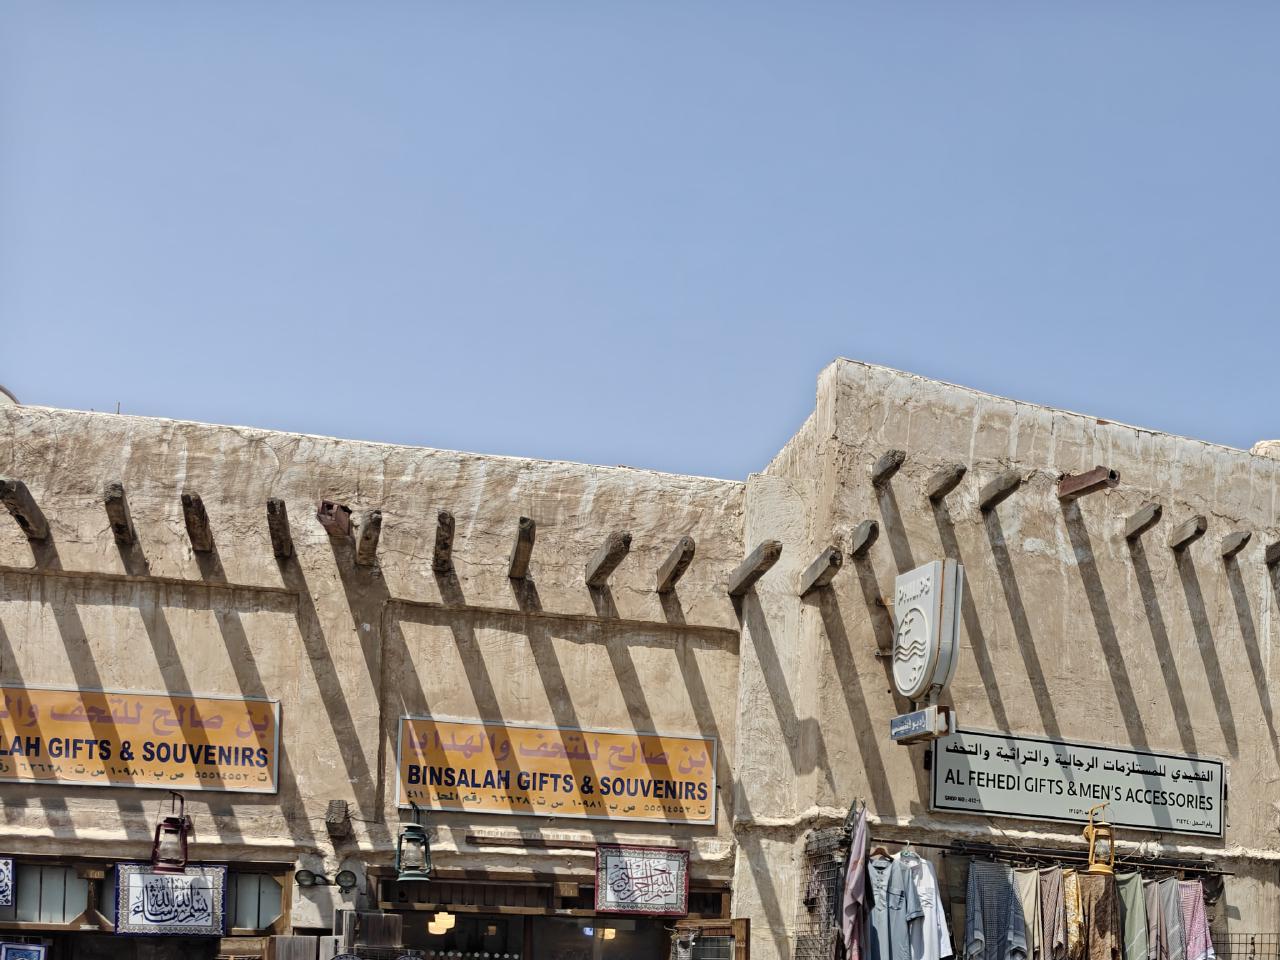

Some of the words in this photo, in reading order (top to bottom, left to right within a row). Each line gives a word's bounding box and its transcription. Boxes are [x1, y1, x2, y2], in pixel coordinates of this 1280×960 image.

[50, 697, 143, 725] للتحف
[151, 703, 225, 736] صالح
[235, 709, 270, 739] بن
[48, 737, 112, 761] GIFTS
[119, 741, 135, 762] &
[142, 741, 269, 768] SOUVENIRS
[408, 729, 511, 762] والهدايا
[519, 732, 600, 761] للتحف
[607, 741, 670, 771] صالح
[677, 745, 707, 775] بن
[945, 742, 990, 761] والتحف
[995, 745, 1050, 767] والتراثية
[1055, 752, 1098, 772] الرجالية
[1103, 759, 1167, 778] للمستلزمات
[1171, 769, 1214, 784] الفهيدي
[407, 764, 510, 790] BINSALAH
[517, 771, 574, 794] GIFTS
[580, 775, 594, 795] &
[600, 776, 708, 801] SOUVENIRS
[945, 768, 964, 786] AL
[968, 770, 1021, 792] FEHEDI
[1024, 776, 1064, 796] GIFTS
[1067, 780, 1078, 797] &
[1080, 782, 1122, 802] MEN'S
[1125, 788, 1214, 811] ACCESSORIES
[463, 791, 483, 804] رقم
